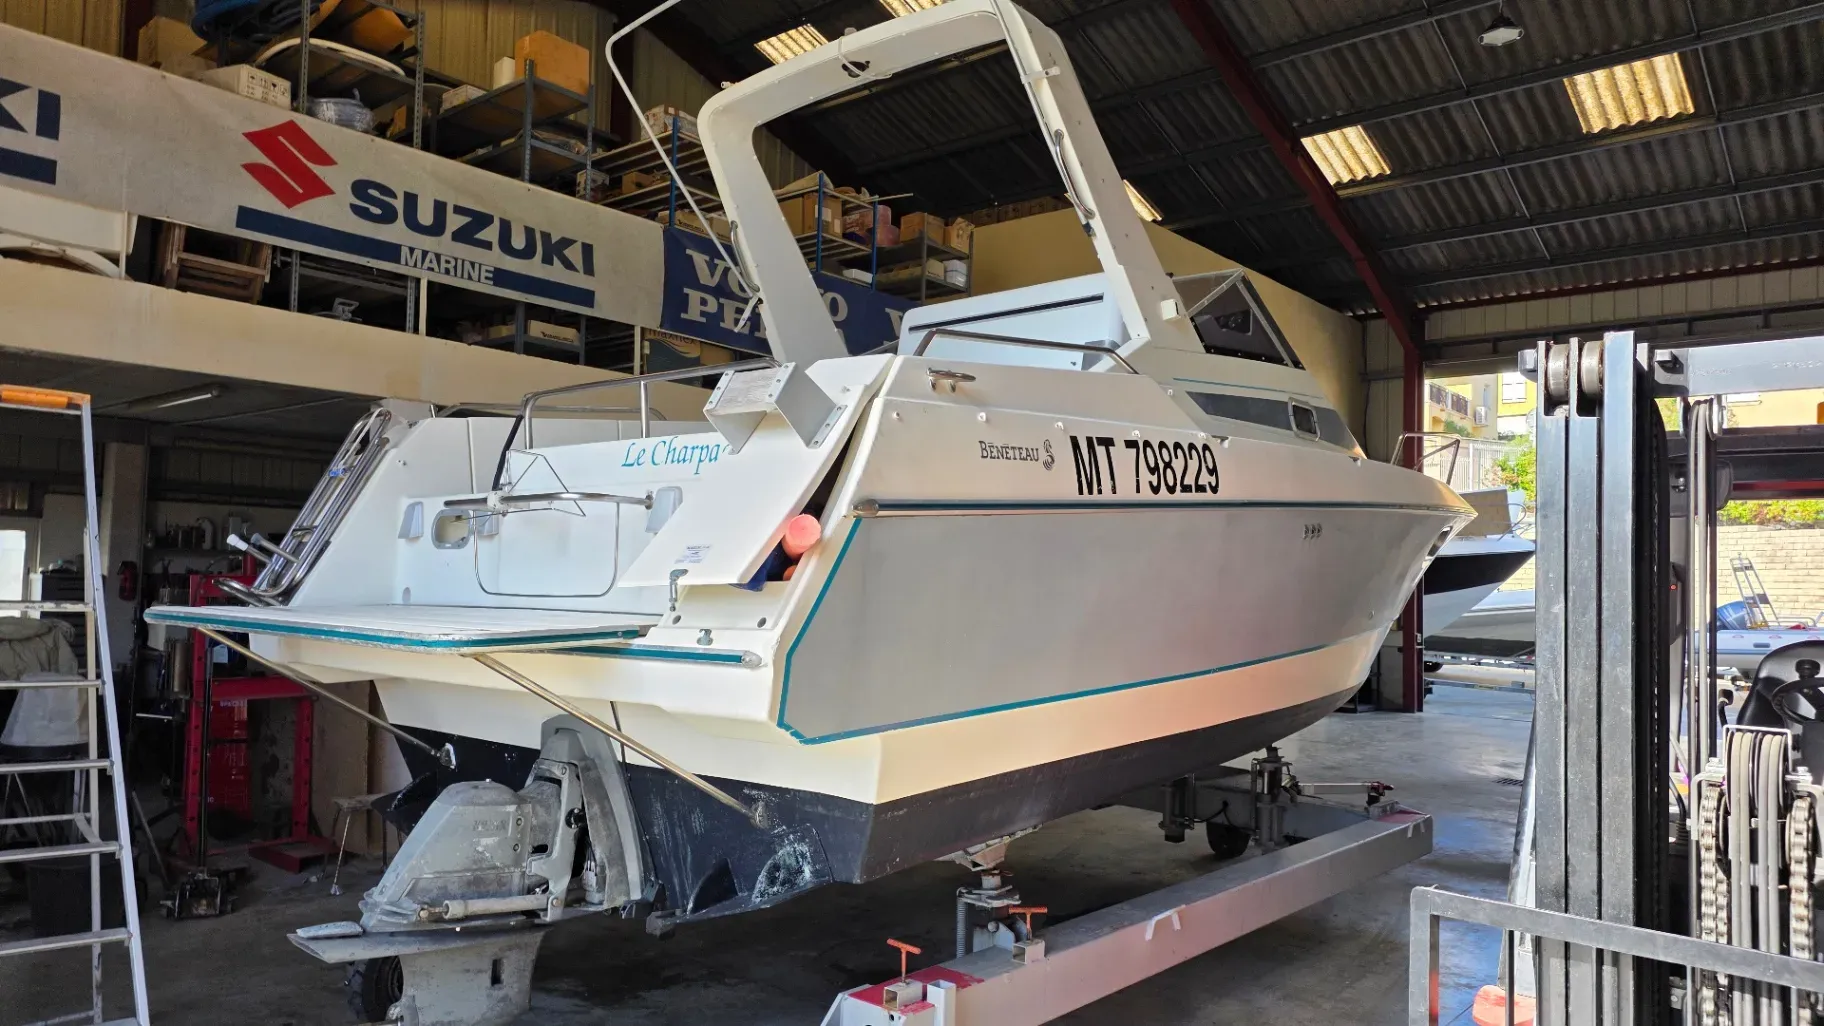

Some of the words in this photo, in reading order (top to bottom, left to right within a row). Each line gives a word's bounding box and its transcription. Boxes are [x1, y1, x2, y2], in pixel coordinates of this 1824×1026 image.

[349, 178, 595, 278] SUZUKI
[400, 245, 494, 286] MARINE
[621, 442, 646, 467] Le
[652, 436, 730, 475] Charpa
[1069, 435, 1117, 496] MT
[1123, 439, 1219, 495] 798229
